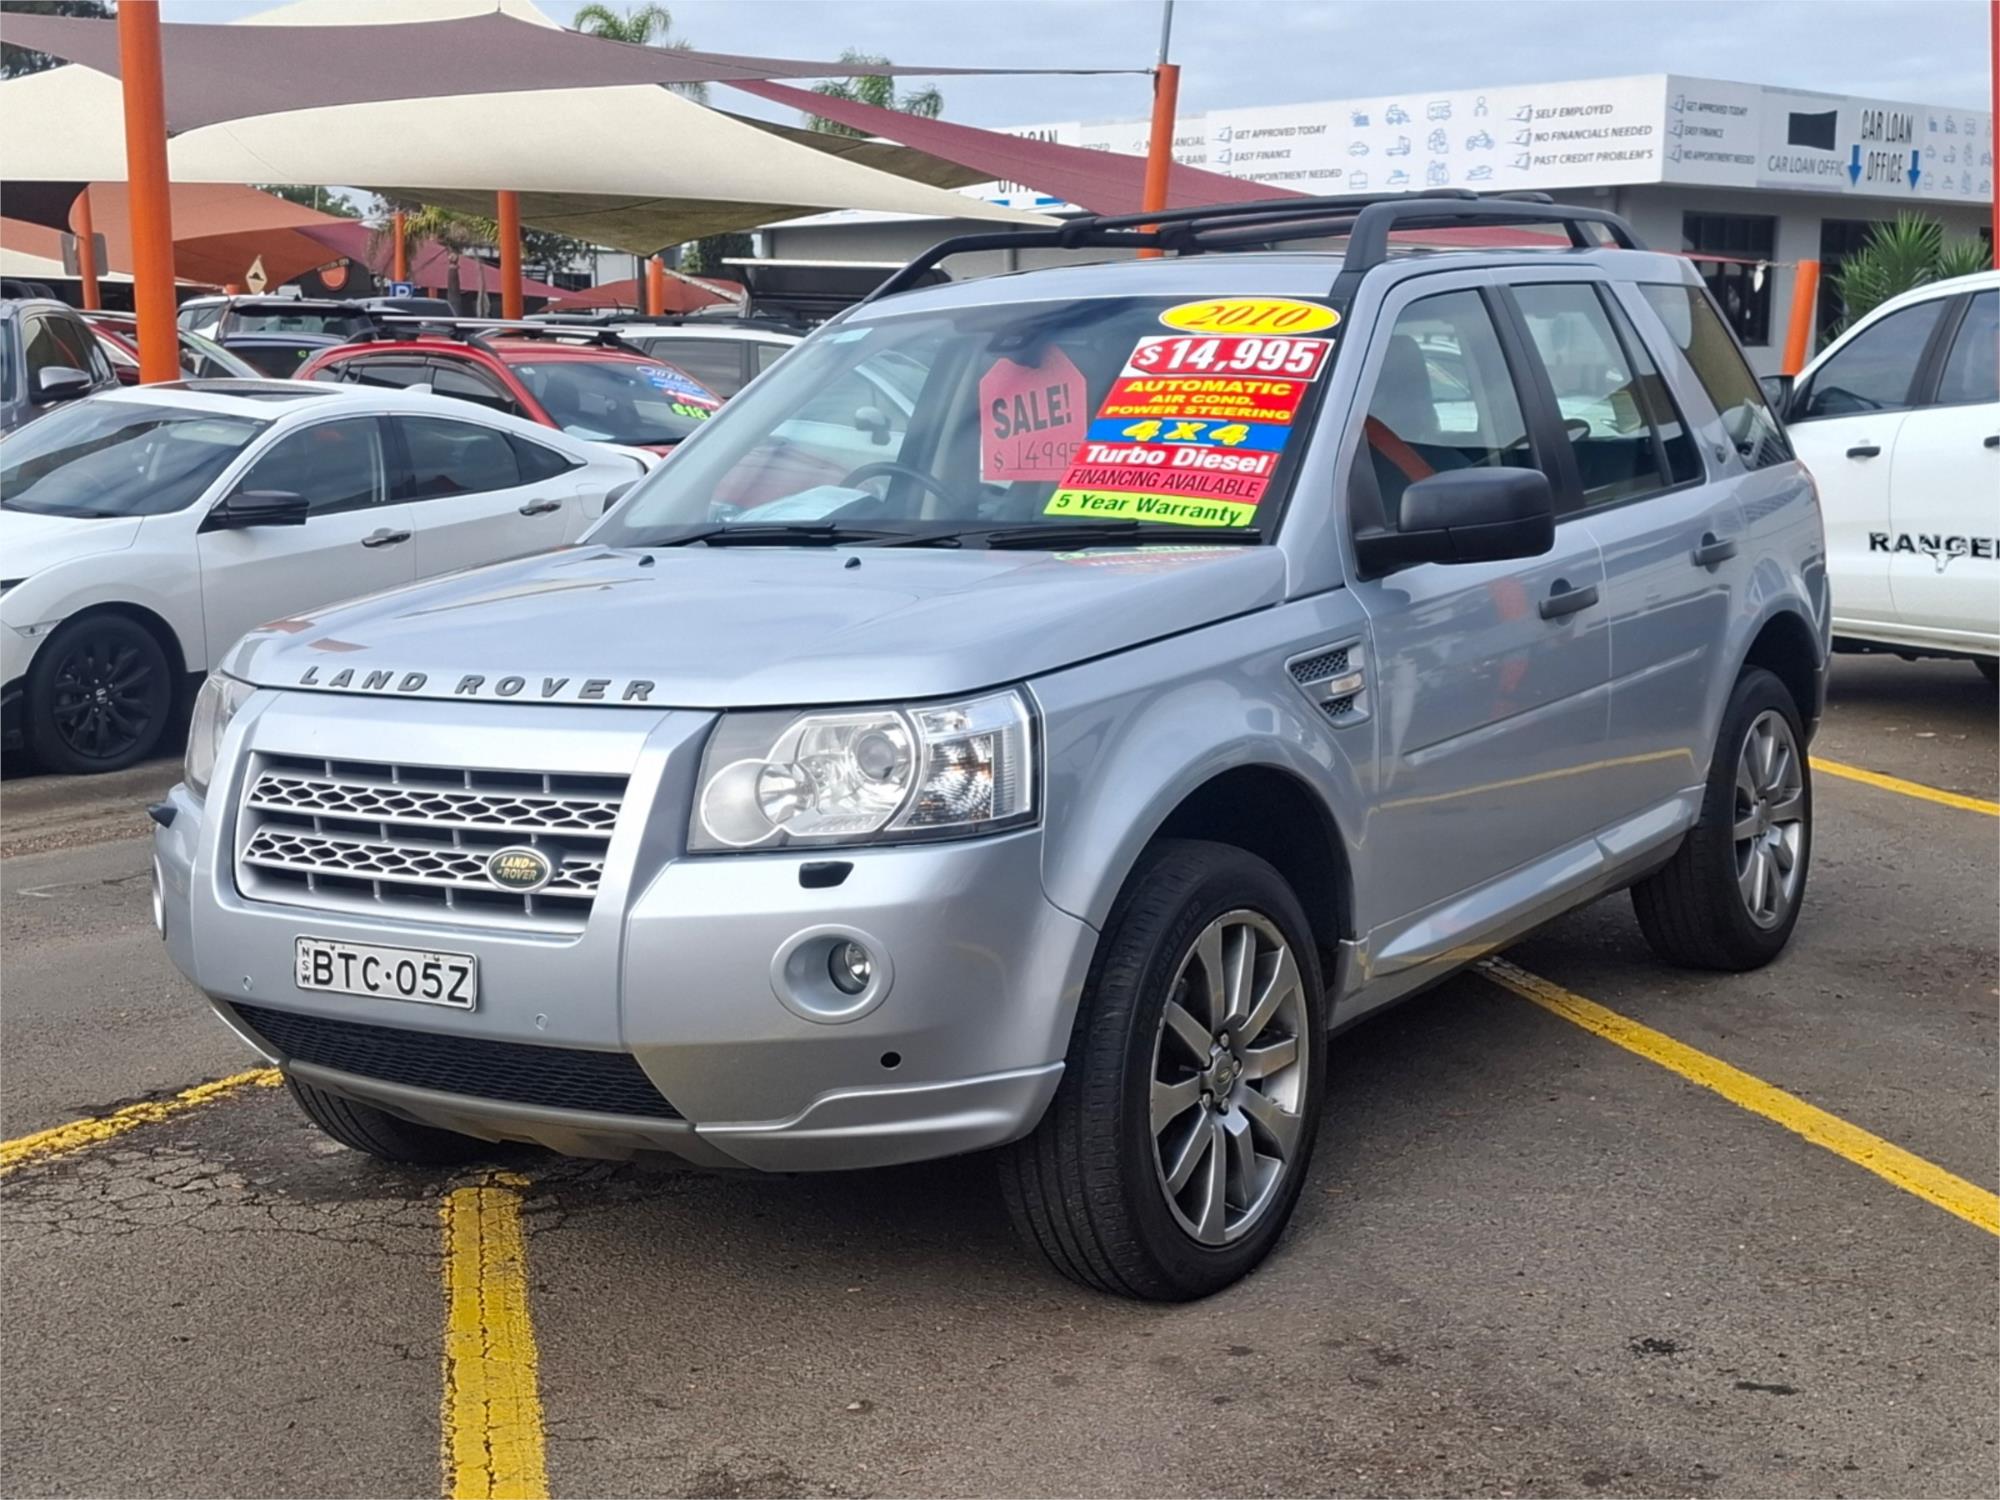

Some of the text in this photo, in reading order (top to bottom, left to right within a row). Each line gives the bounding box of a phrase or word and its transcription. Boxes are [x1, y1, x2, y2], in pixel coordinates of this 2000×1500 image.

[1535, 104, 1613, 119] SELF EMPLOYED
[1234, 125, 1327, 140] GET APPROVED TODAY
[1534, 125, 1653, 142] NO FINANCIALS NEEDED
[1862, 110, 1914, 143] CAR LOAN
[1234, 149, 1291, 162] EASY FINANCE
[1533, 149, 1654, 166] PAST CREDIT PROBLEM'S
[1309, 168, 1342, 178] NEEDED
[1768, 155, 1787, 173] CAR
[1789, 157, 1816, 175] LOAN
[1867, 150, 1903, 184] OFFICE
[396, 285, 410, 297] P
[1184, 305, 1312, 328] 2010
[1124, 379, 1291, 396] AUTOMATIC
[1149, 393, 1255, 406] AIR COND.
[992, 383, 1072, 440] SALE!
[1105, 405, 1291, 421] POWER STEERING
[1084, 444, 1269, 474] Turbo Diesel
[1066, 468, 1261, 499] FINANCING AVAILABLE
[1055, 494, 1242, 526] 5 Year Warranty
[299, 665, 656, 701] LAND ROVER
